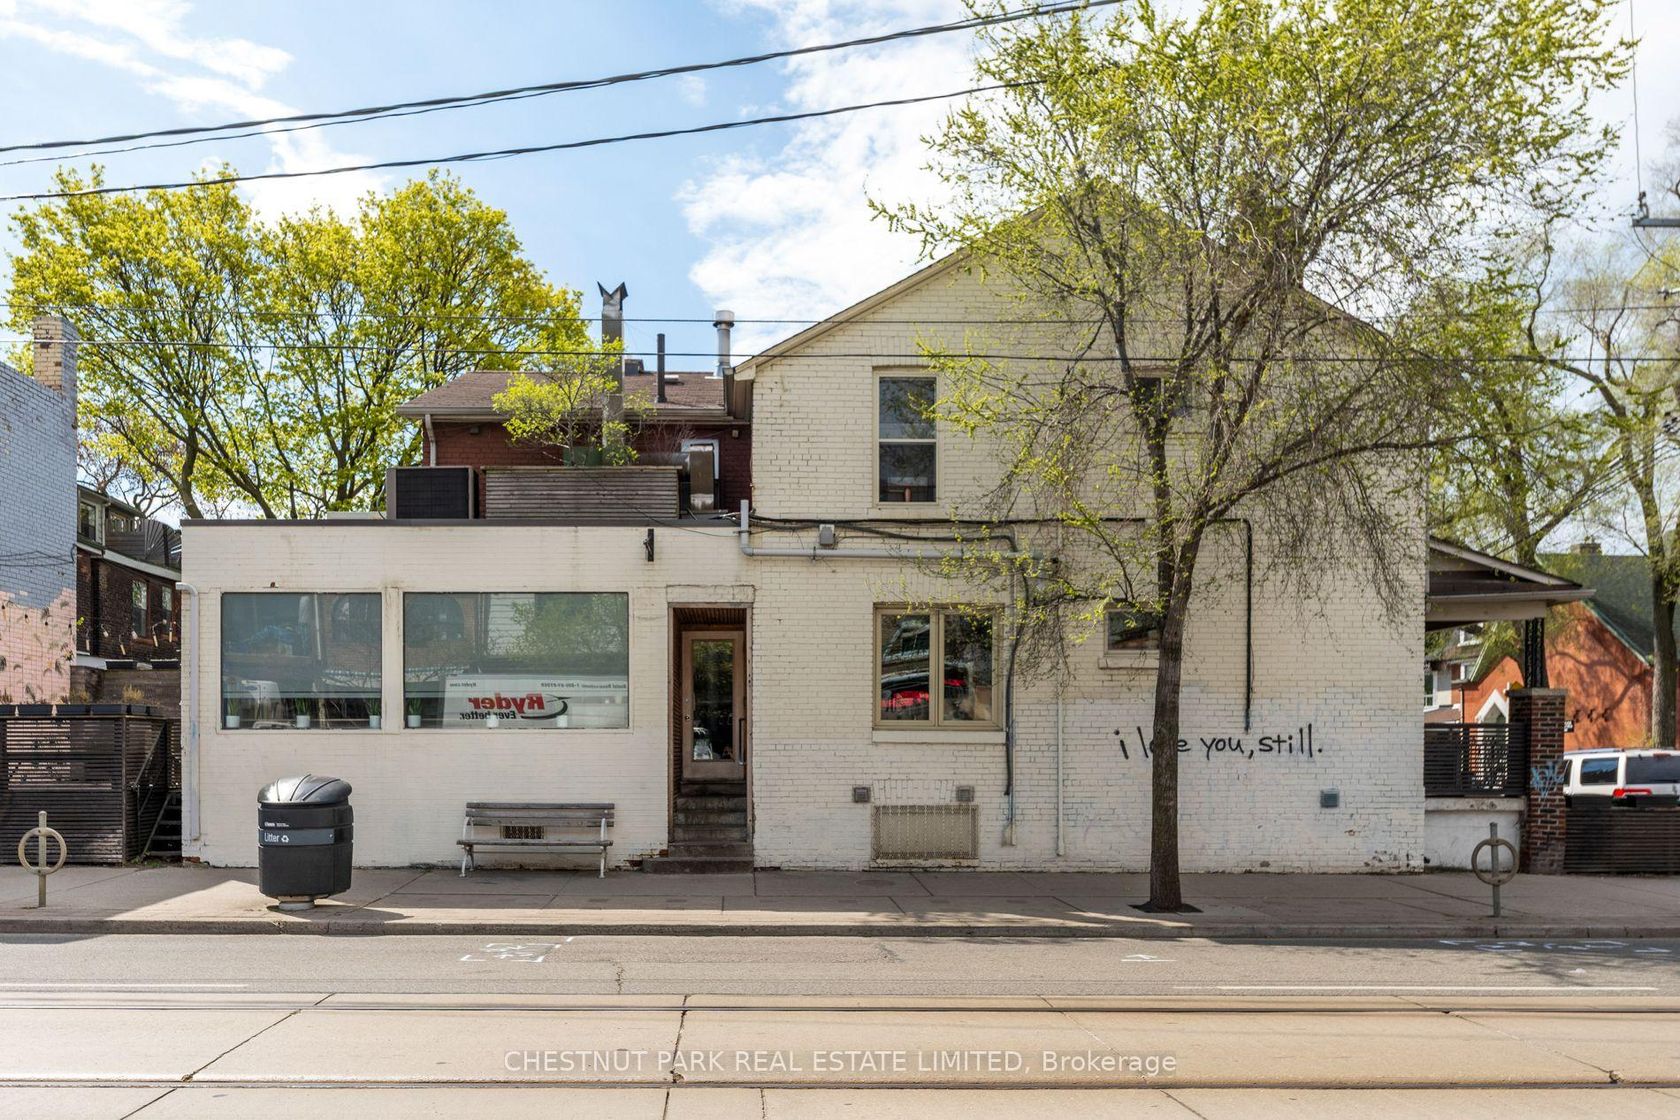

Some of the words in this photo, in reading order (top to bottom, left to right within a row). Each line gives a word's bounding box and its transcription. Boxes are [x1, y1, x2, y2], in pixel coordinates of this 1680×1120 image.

[1114, 728, 1129, 760] i
[1136, 726, 1192, 759] le
[264, 832, 280, 843] Litter
